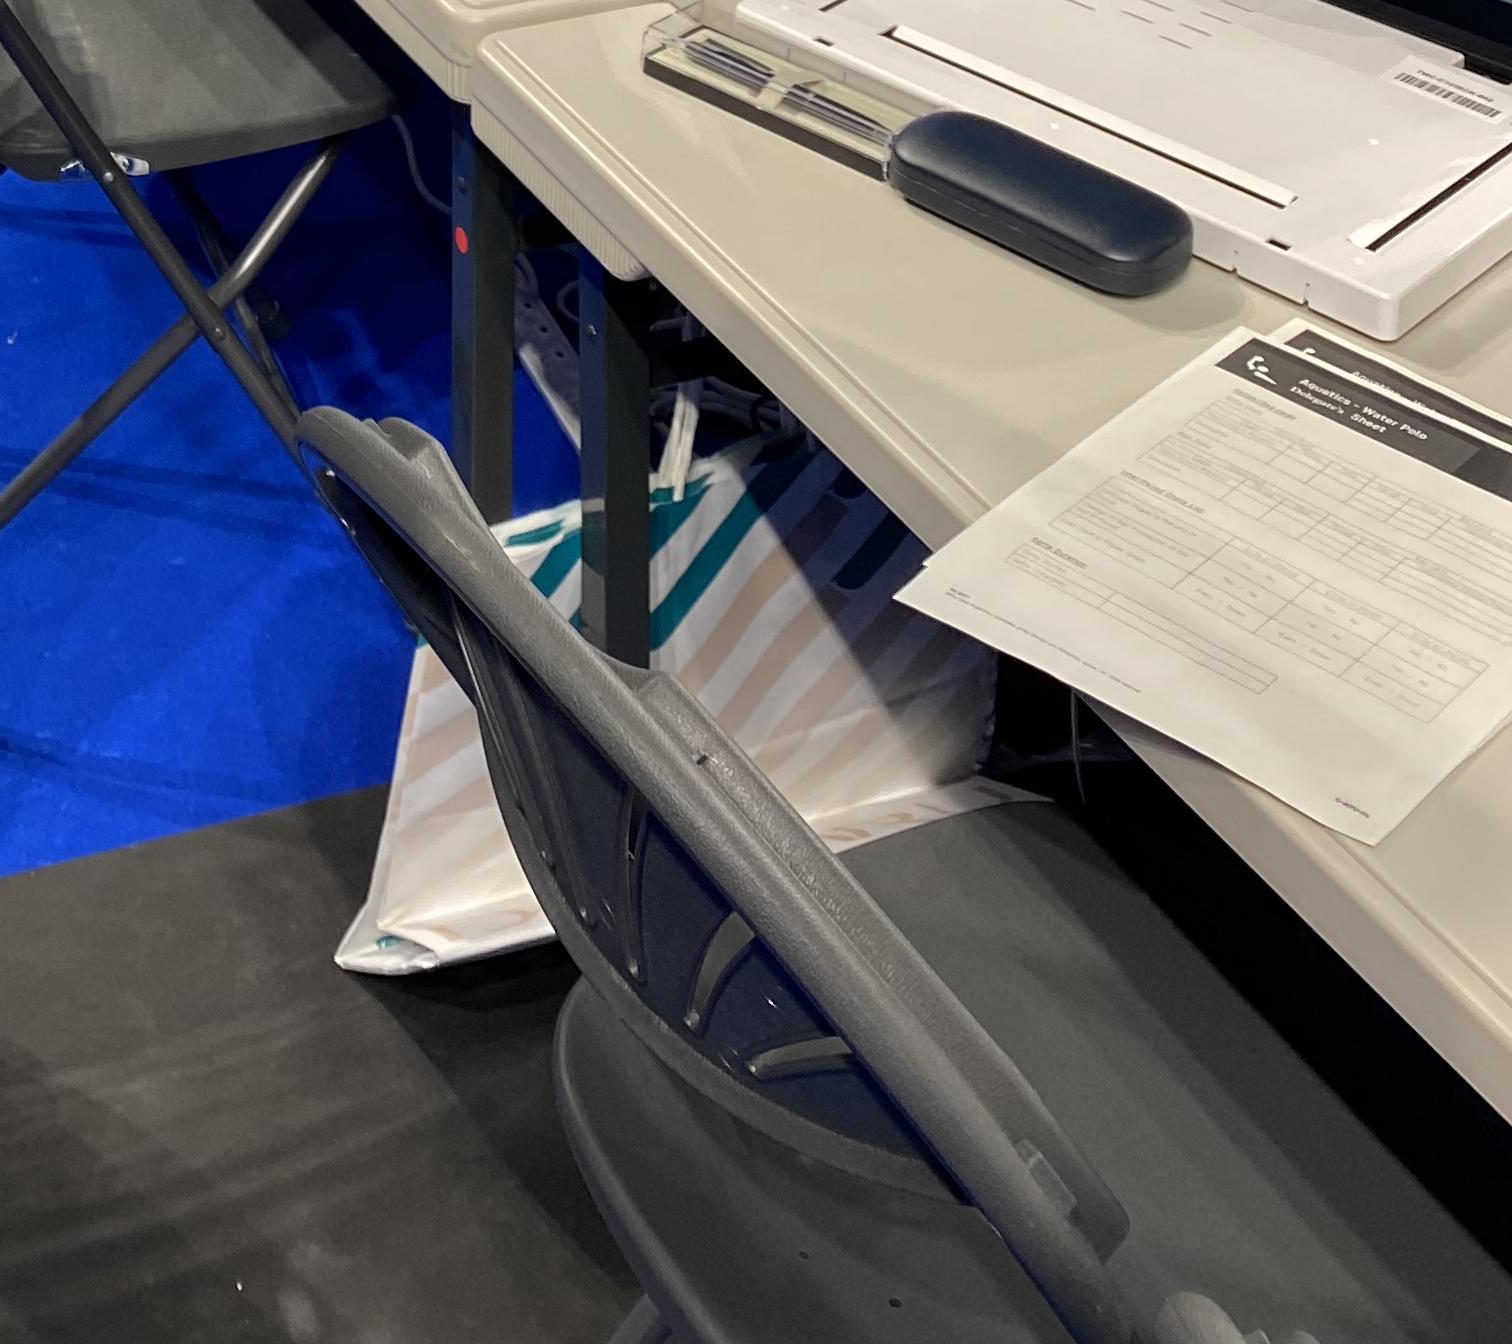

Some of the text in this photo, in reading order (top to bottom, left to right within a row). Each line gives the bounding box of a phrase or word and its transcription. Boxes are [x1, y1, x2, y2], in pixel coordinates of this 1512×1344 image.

[1289, 385, 1345, 415] Delegate's
[1350, 413, 1387, 434] Sheet
[1298, 378, 1352, 407] Aquatics
[1362, 406, 1399, 427] Water
[1399, 423, 1428, 441] Polo
